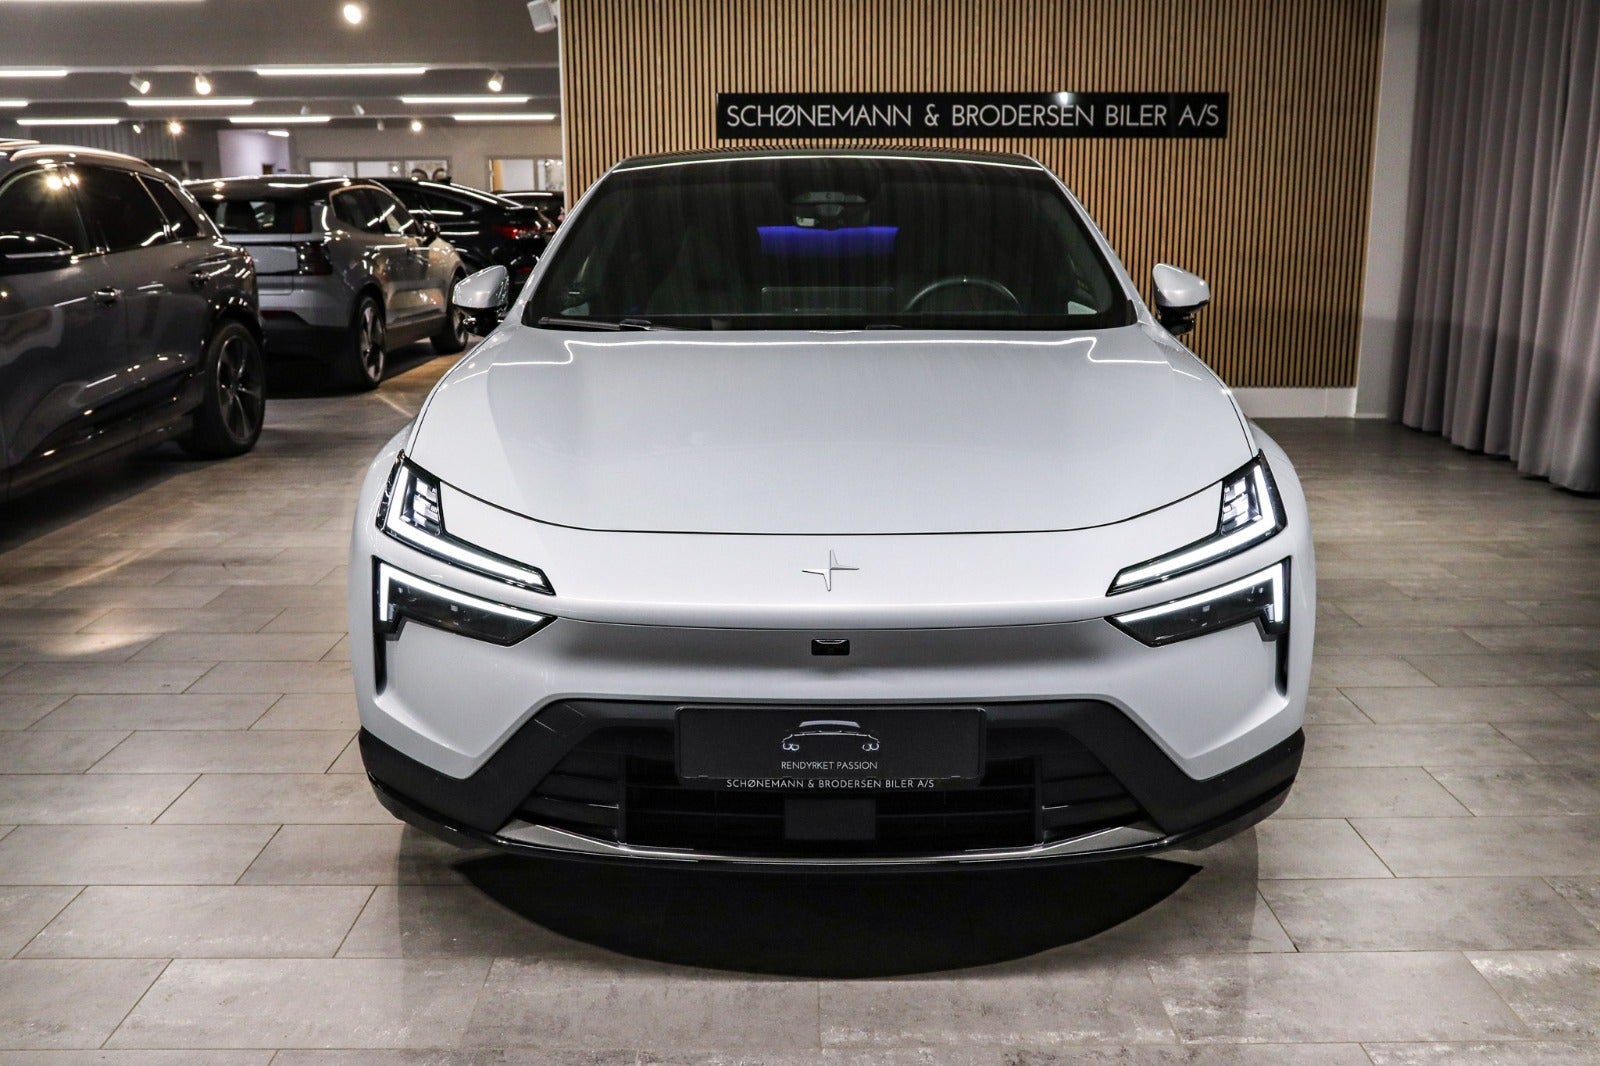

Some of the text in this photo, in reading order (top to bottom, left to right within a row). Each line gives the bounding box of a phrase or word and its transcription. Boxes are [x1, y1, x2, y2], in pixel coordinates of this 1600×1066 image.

[727, 103, 1219, 127] SCHØNEMANN & BRODERSEN BILER A/S
[781, 761, 878, 770] RENDYRKET PASSION
[726, 779, 935, 788] SCHØNEMANN & BRODERSEN BILER A/S
